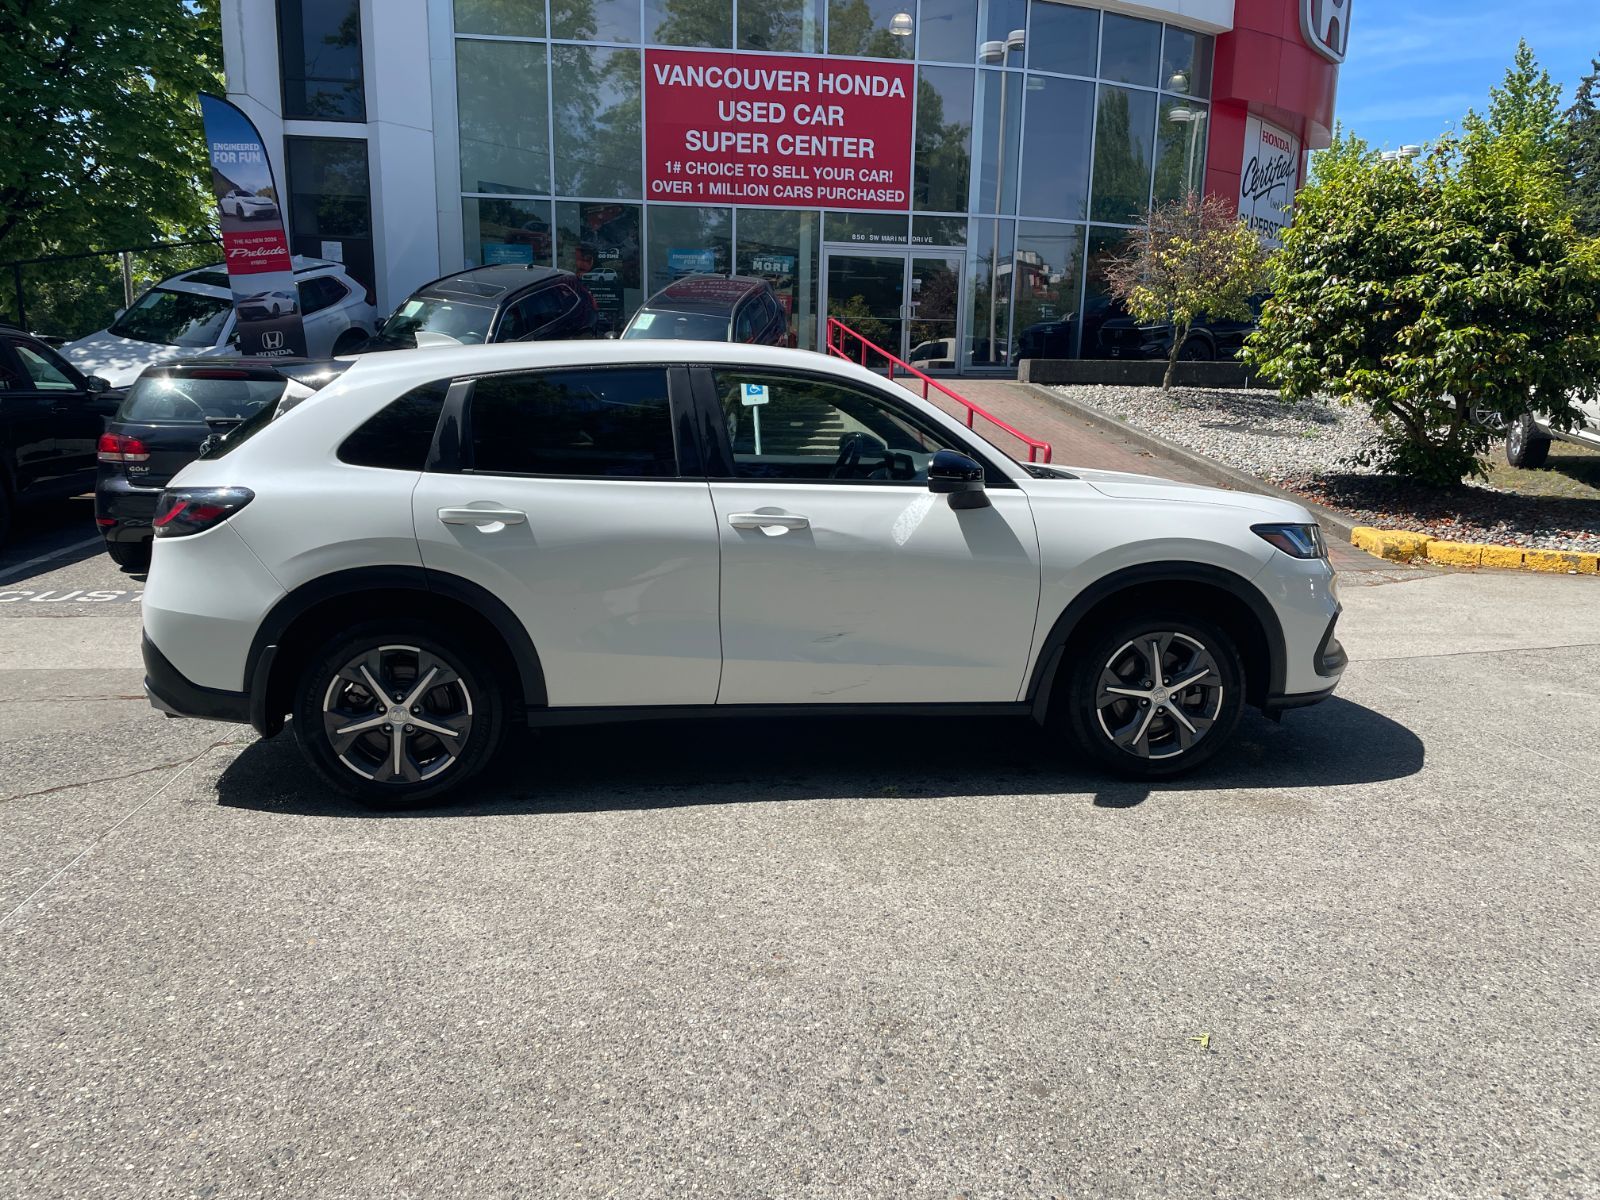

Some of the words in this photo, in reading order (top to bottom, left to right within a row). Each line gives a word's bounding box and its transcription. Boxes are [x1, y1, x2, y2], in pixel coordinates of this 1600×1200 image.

[653, 64, 810, 93] VANCOUVER
[818, 73, 905, 98] HONDA
[718, 101, 786, 123] USED
[793, 104, 844, 126] CAR
[213, 143, 260, 151] ENGINEERED
[685, 130, 768, 154] SUPER
[776, 134, 875, 159] CENTER
[1262, 131, 1290, 153] HONDA
[214, 151, 236, 163] FOR
[239, 152, 261, 163] FUN
[665, 161, 681, 174] 1#
[686, 162, 744, 177] CHOICE
[748, 164, 768, 177] TO
[772, 166, 809, 180] SELL
[813, 167, 855, 181] YOUR
[858, 169, 893, 183] CAR!
[1241, 150, 1295, 200] Certified
[652, 180, 692, 194] OVER
[697, 182, 703, 194] 1
[709, 183, 769, 197] MILLION
[773, 185, 813, 199] CARS
[817, 187, 905, 203] PURCHASED
[881, 235, 907, 243] MARINE
[228, 246, 287, 258] Prelude
[752, 261, 790, 273] MORE
[255, 348, 295, 358] HONDA
